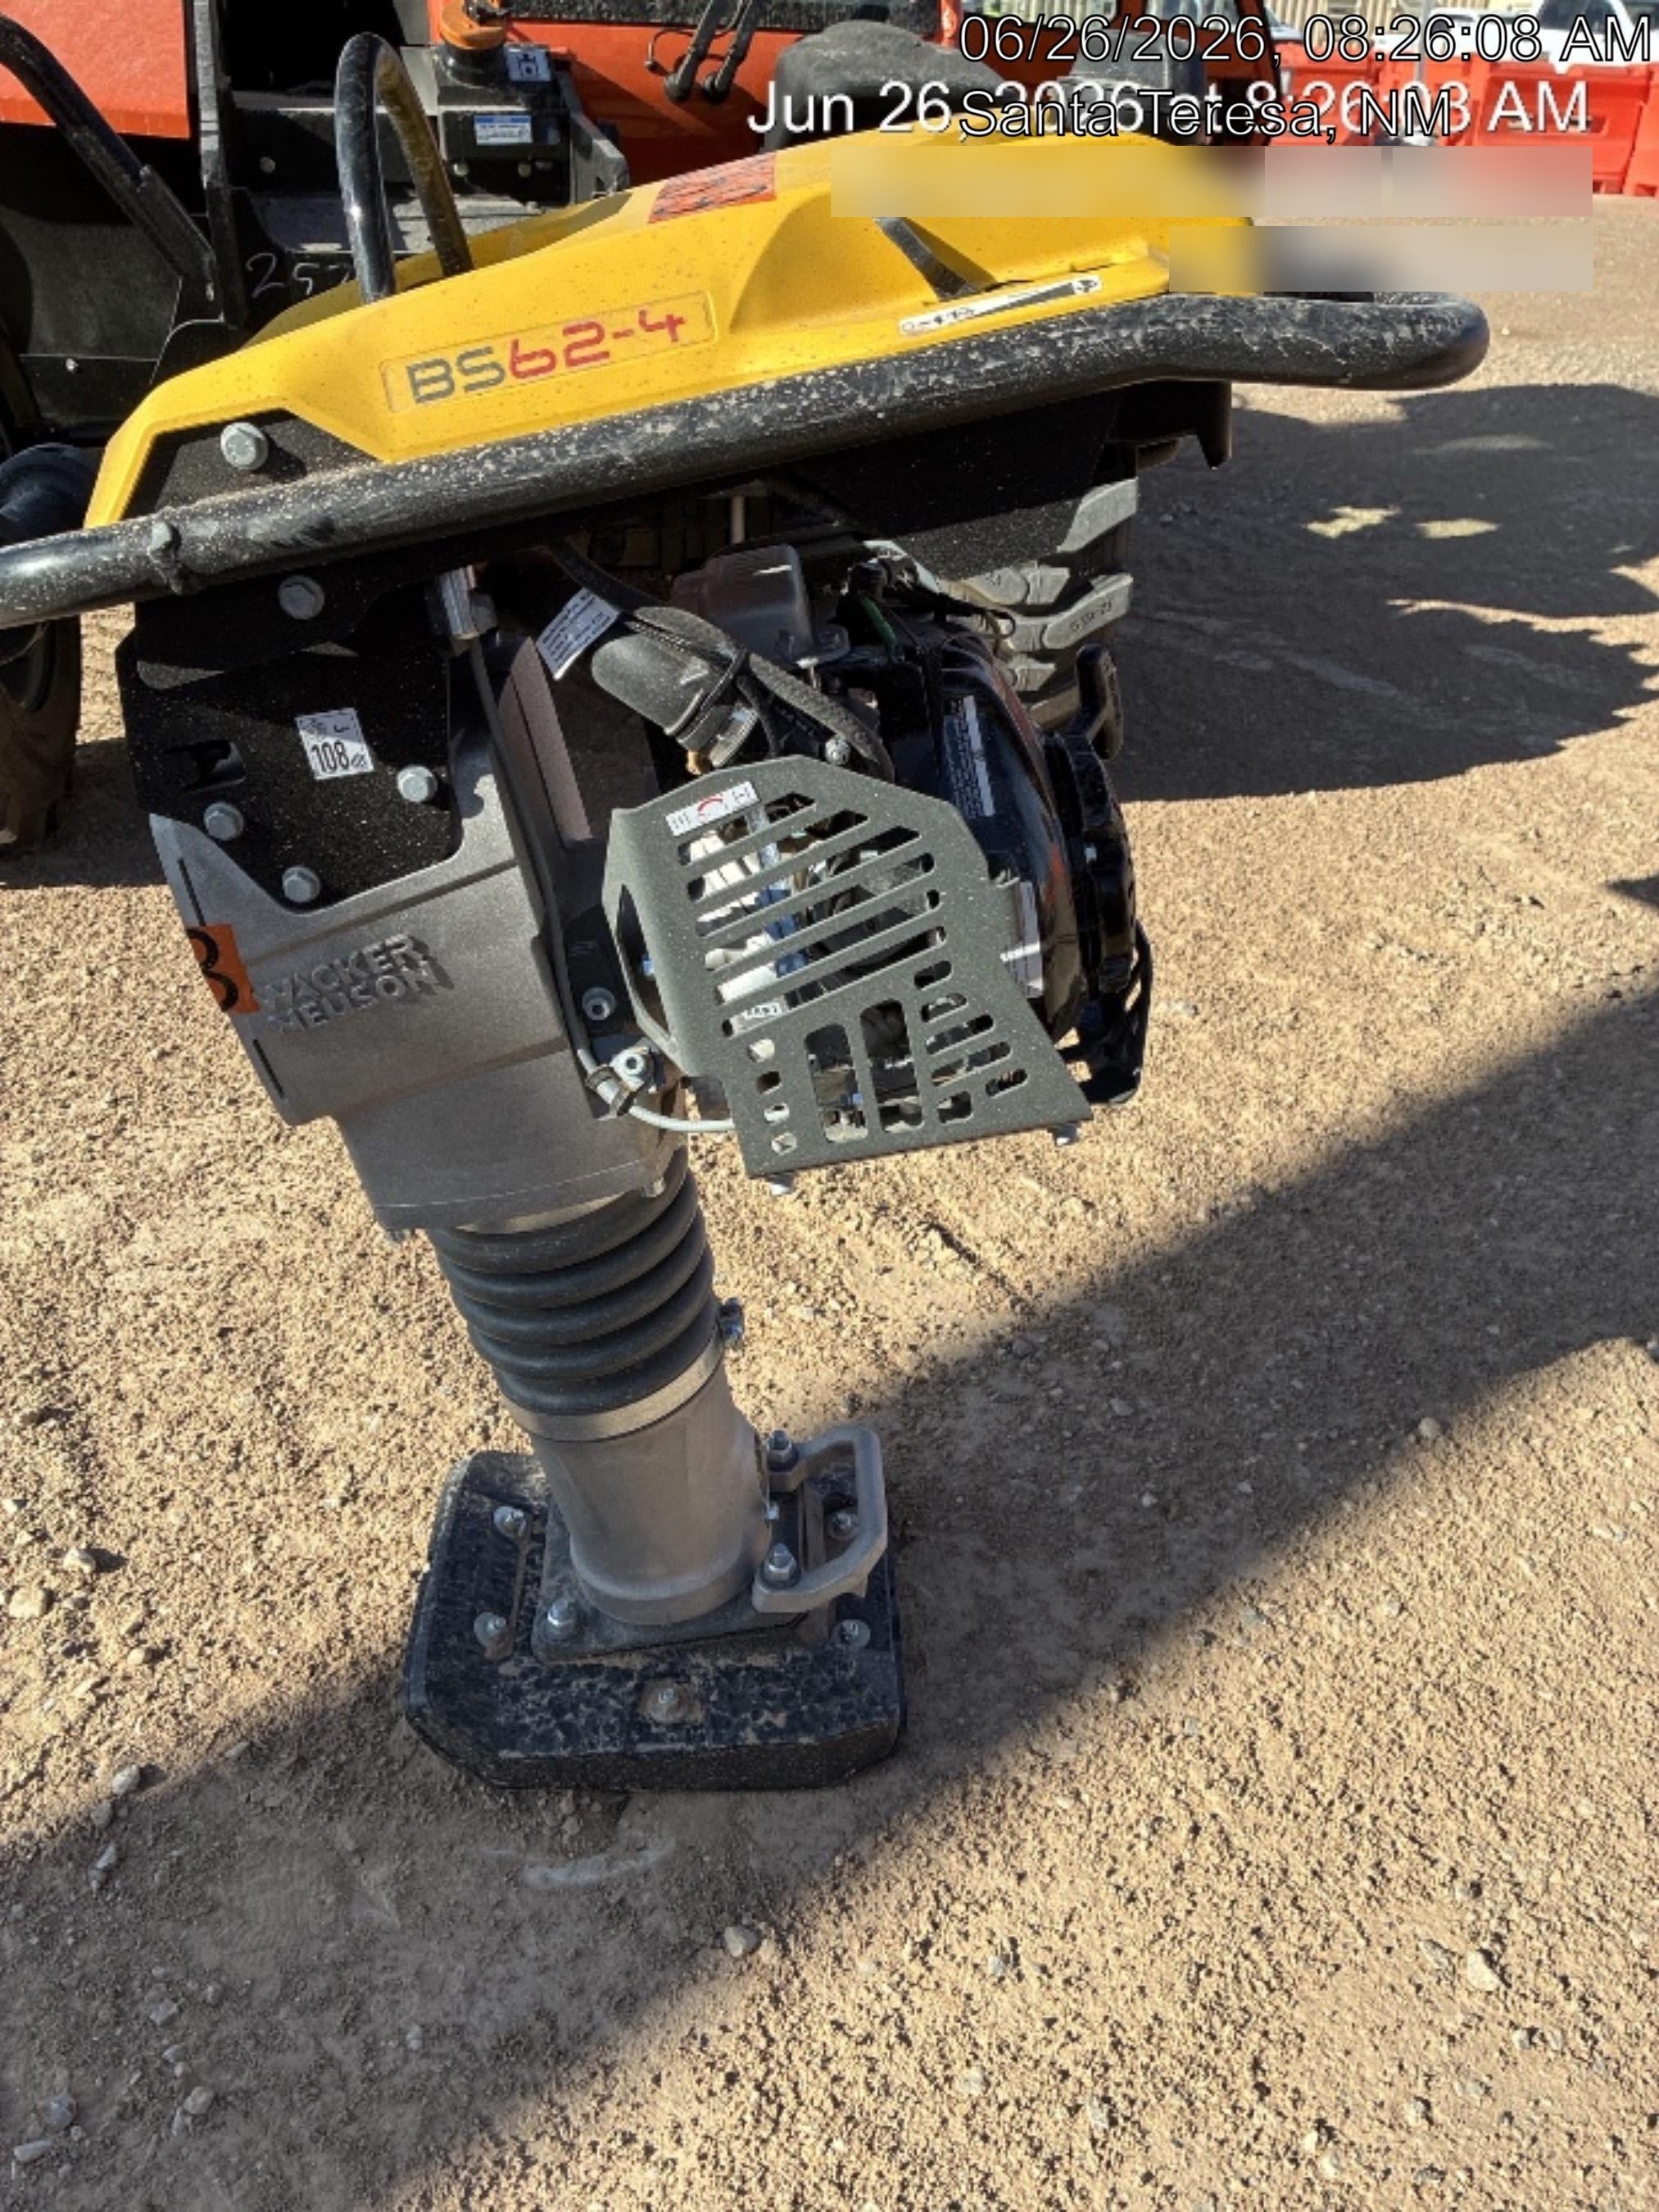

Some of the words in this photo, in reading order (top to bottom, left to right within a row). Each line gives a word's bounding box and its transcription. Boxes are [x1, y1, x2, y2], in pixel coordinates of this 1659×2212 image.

[406, 309, 686, 404] BS62-4
[311, 740, 349, 772] 108
[264, 932, 419, 1013] WACKER
